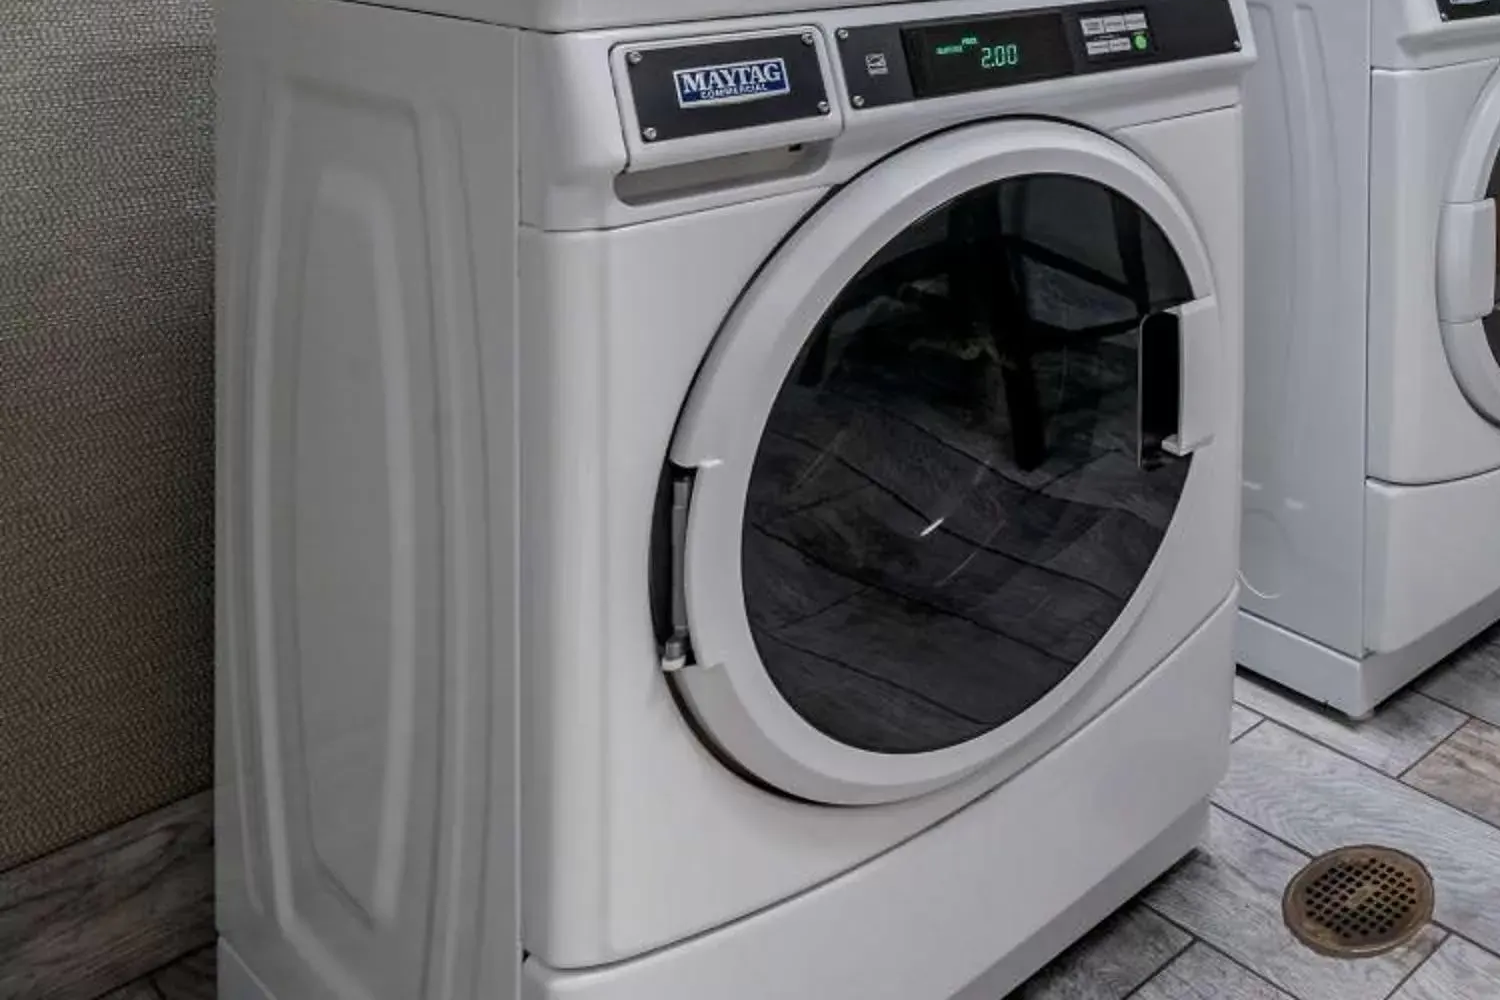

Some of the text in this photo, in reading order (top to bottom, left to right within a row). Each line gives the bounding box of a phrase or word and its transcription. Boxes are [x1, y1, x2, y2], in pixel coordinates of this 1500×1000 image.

[980, 43, 1019, 69] 2.00
[681, 63, 781, 95] MAYTAG
[700, 83, 768, 99] COMMERCIAL
